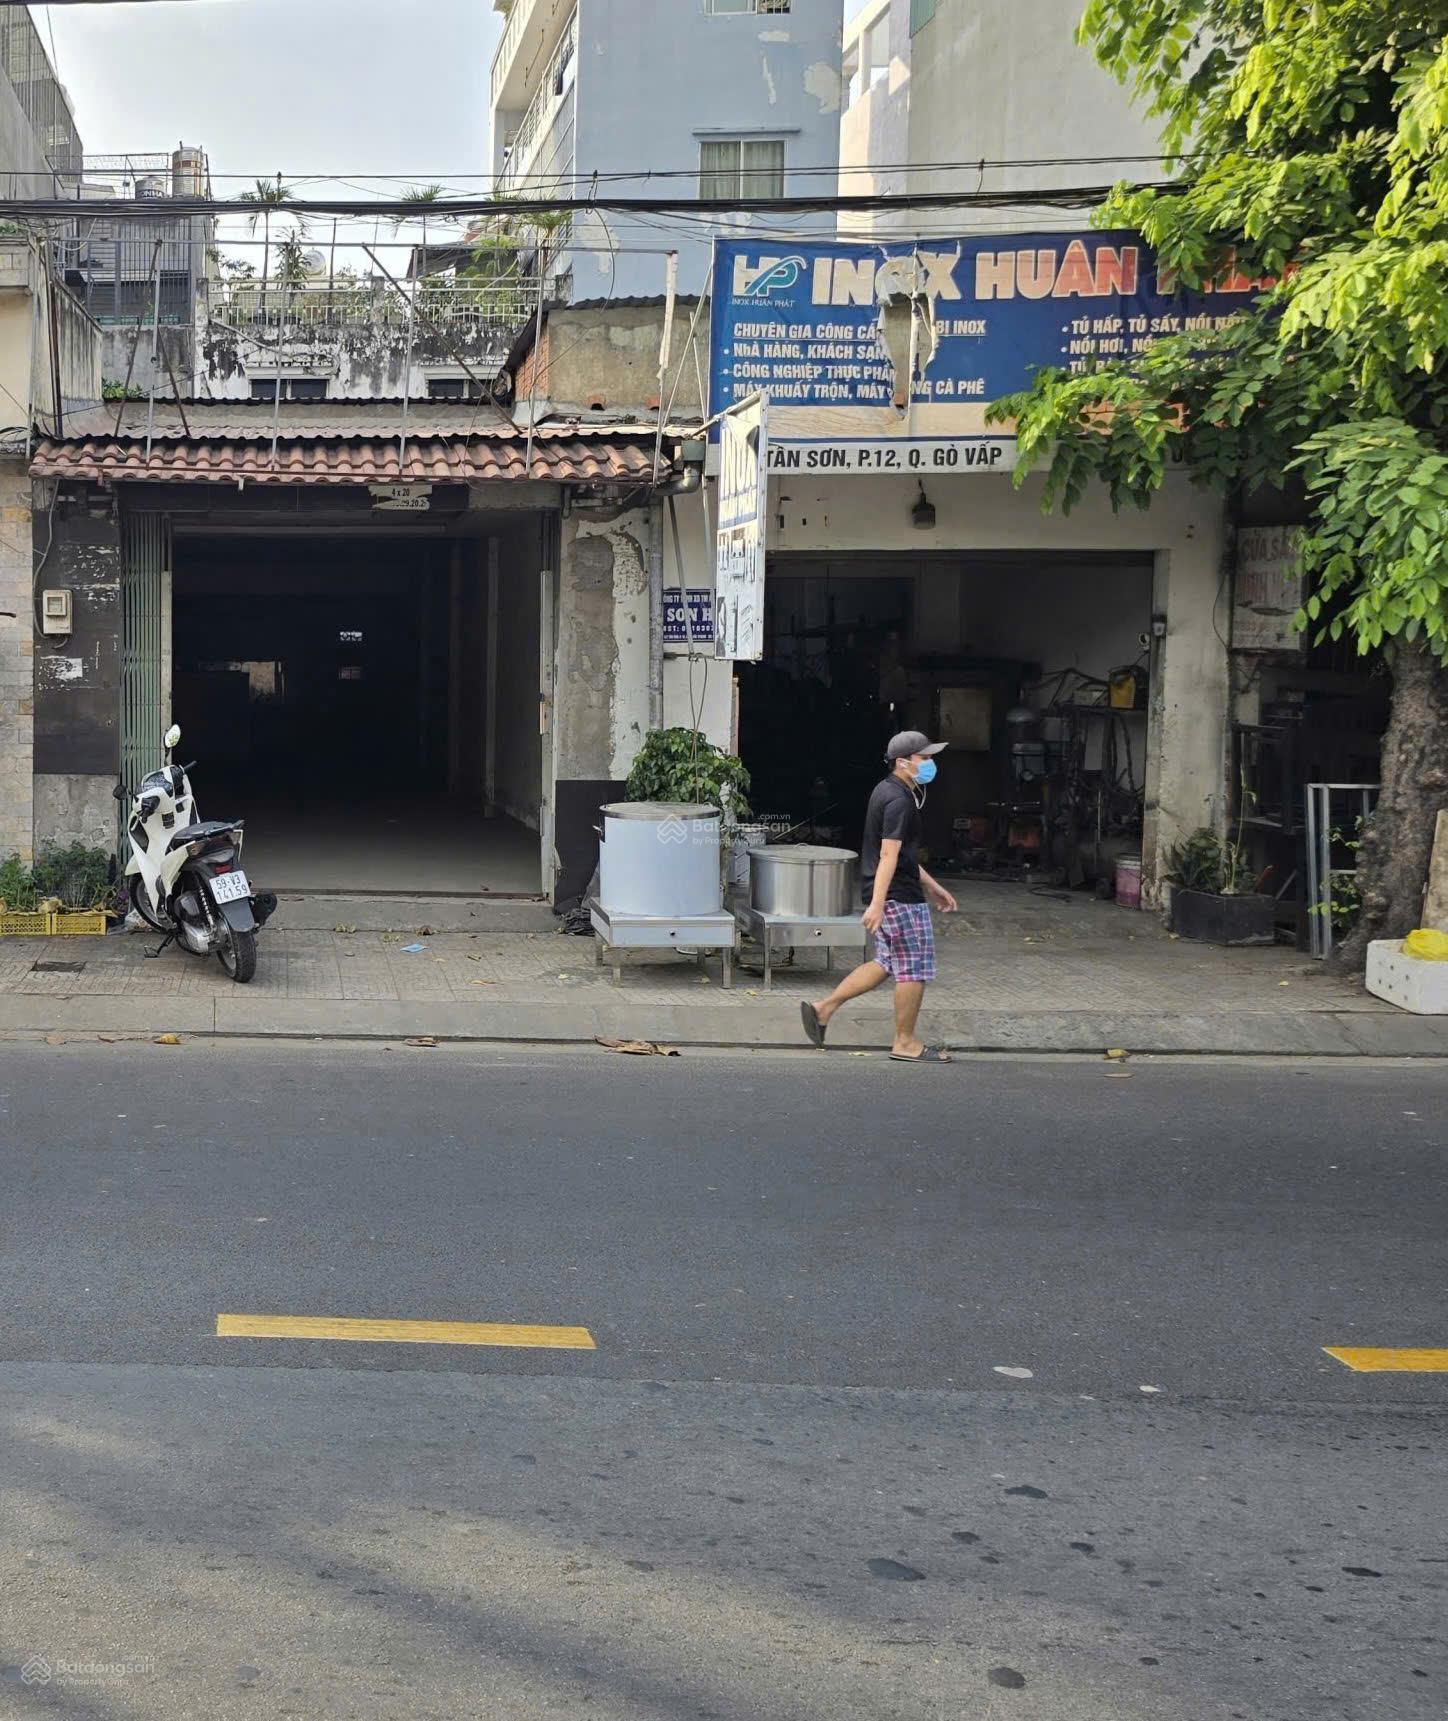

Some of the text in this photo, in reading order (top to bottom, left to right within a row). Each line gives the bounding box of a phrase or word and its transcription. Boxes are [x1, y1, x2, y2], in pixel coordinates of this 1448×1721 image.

[732, 255, 807, 297] HP
[975, 239, 1138, 300] HUÂN
[733, 322, 786, 338] CHUYÊN
[788, 324, 812, 338] GIA
[816, 323, 854, 339] CÔNG
[857, 322, 880, 340] CÁ
[953, 320, 986, 334] INOX
[1071, 315, 1090, 334] TỦ
[1093, 313, 1124, 334] HẤP,
[1128, 314, 1147, 333] TỦ
[1150, 313, 1180, 333] SẤY,
[763, 341, 804, 360] HÀNG,
[807, 342, 853, 359] KHÁCH
[733, 361, 770, 378] CÔNG
[773, 363, 823, 382] NGHIỆP
[826, 364, 861, 382] THỰC
[814, 381, 853, 401] TRỘN,
[857, 382, 887, 399] MÁY
[935, 378, 954, 395] CÀ
[957, 378, 985, 395] PHÊ
[767, 440, 1002, 470] TÂN SƠN, P.12, Q. GÒ VẤP
